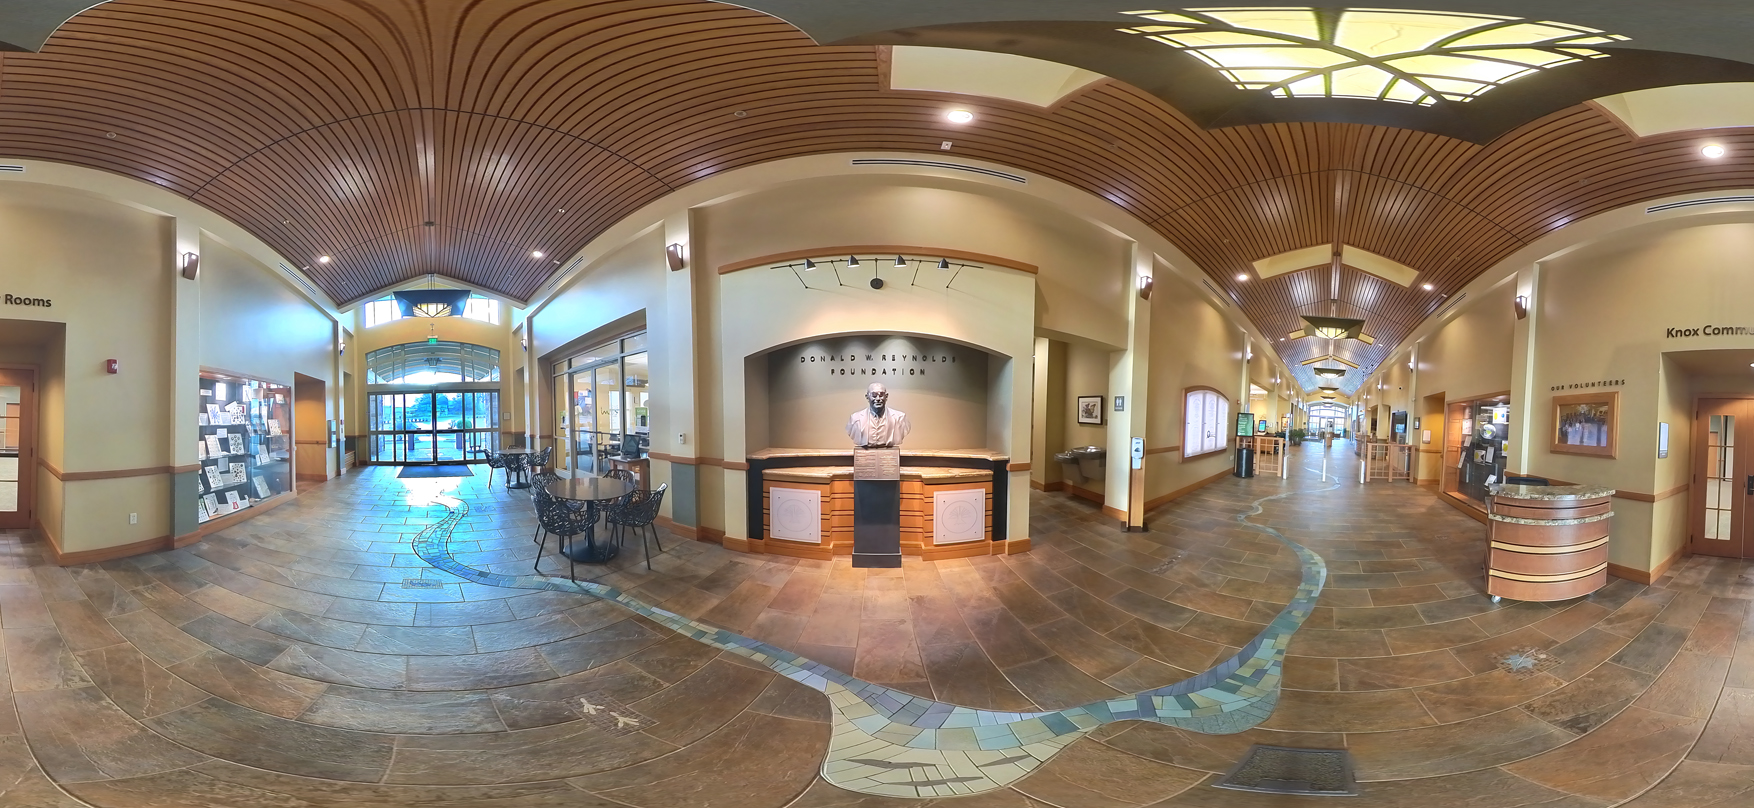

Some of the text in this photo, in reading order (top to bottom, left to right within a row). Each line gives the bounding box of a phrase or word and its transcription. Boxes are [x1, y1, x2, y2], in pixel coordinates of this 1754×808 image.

[4, 293, 52, 307] Rooms
[1666, 327, 1700, 339] Knox
[800, 354, 856, 363] DONALD
[881, 354, 956, 363] REYNOLDS
[830, 368, 926, 376] FOUNDATION
[1569, 379, 1626, 390] VOLUNTEERS
